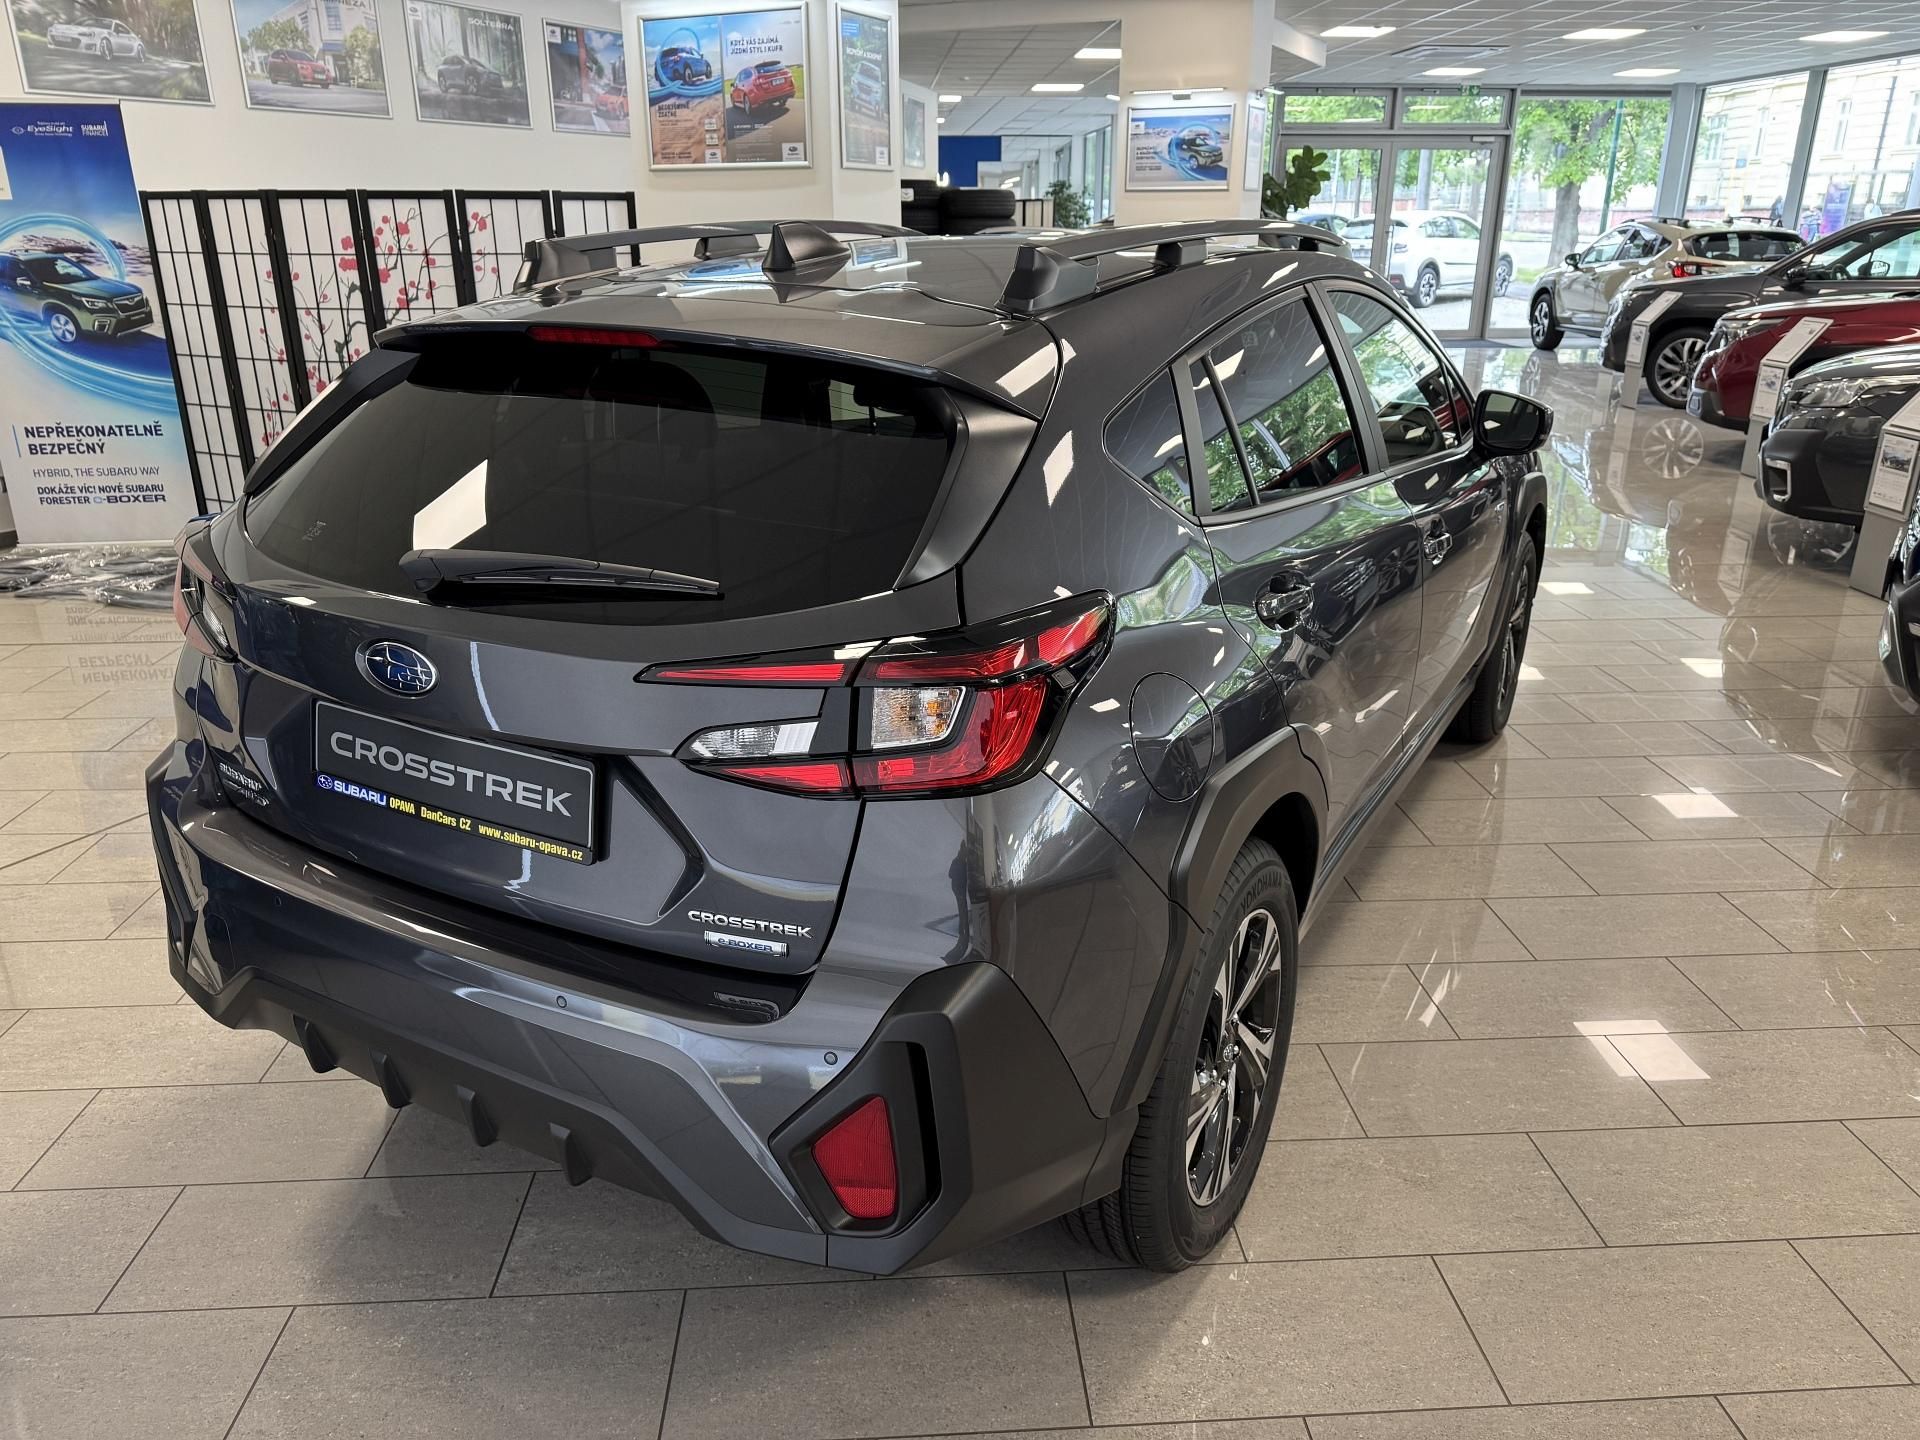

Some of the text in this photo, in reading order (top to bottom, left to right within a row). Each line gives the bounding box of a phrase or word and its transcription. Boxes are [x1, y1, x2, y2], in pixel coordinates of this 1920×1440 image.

[467, 17, 514, 31] SOLTERRA
[27, 125, 73, 133] EyeSight
[24, 420, 164, 439] NEPŘEKONATELNĚ
[28, 439, 105, 455] BEZPEČNÝ
[33, 466, 160, 478] HYBRID, THE SUBARU WAY
[37, 484, 76, 495] DOKÁŽE
[98, 482, 124, 493] NOVÉ
[126, 483, 164, 493] SUBARU
[39, 496, 91, 505] FORESTER
[330, 731, 572, 817] CROSSTREK
[334, 780, 583, 861] SUBARU OPAVA DanCars CZ www.subaru-opava.cz
[1240, 871, 1282, 916] YOKOHAMA
[687, 910, 812, 939] CROSSTREK
[717, 938, 774, 953] e-BOXER
